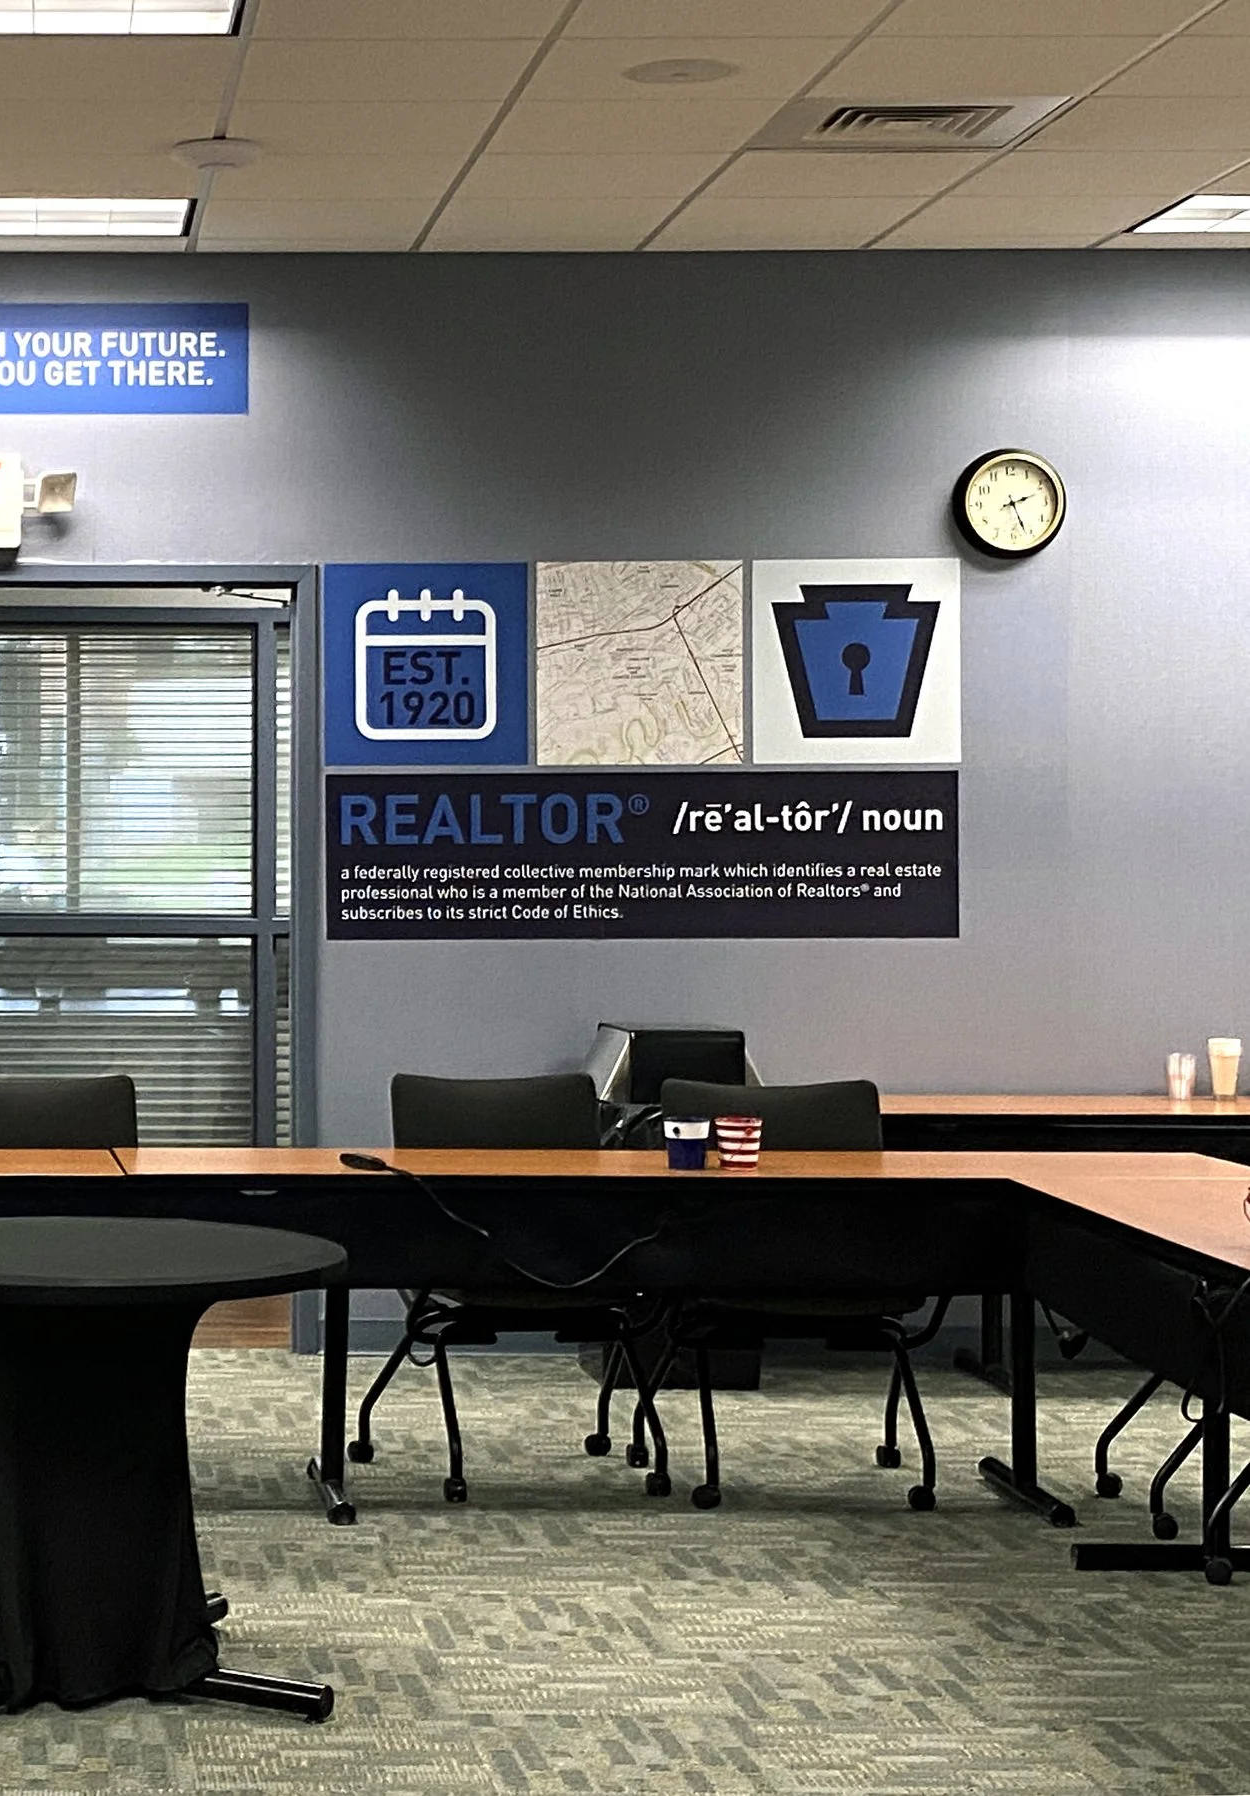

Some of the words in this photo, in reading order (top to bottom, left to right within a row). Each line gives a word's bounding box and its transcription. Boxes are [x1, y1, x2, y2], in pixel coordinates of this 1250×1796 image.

[14, 332, 92, 357] YOUR
[101, 332, 226, 358] FUTURE.
[45, 360, 99, 386] GET
[108, 360, 214, 386] THERE.
[989, 471, 998, 482] 11
[1005, 466, 1016, 476] 12
[978, 485, 990, 495] 10
[1038, 480, 1043, 490] 2
[975, 501, 982, 511] 9
[383, 651, 469, 685] EST.
[379, 691, 474, 725] 1920
[863, 809, 943, 831] noun
[341, 869, 349, 879] a
[354, 865, 419, 882] federally
[424, 865, 499, 882] registered
[504, 865, 574, 878] collective
[579, 864, 675, 880] membership
[680, 864, 719, 877] mark
[724, 864, 767, 877] which
[773, 863, 842, 877] identifies
[847, 867, 855, 877] a
[861, 863, 890, 876] real
[895, 864, 941, 877] estate
[342, 885, 433, 903] professional
[437, 885, 467, 898] who
[473, 885, 485, 898] is
[490, 888, 497, 898] a
[503, 885, 567, 898] member
[571, 884, 585, 898] of
[590, 884, 613, 898] the
[619, 884, 682, 898] National
[687, 884, 772, 898] Association
[778, 883, 791, 897] of
[874, 883, 901, 897] and
[342, 905, 423, 919] subscribes
[428, 907, 441, 919] to
[446, 906, 464, 919] its
[469, 906, 507, 919] strict
[512, 905, 549, 919] Code
[554, 905, 568, 918] of
[574, 905, 623, 918] Ethics.
